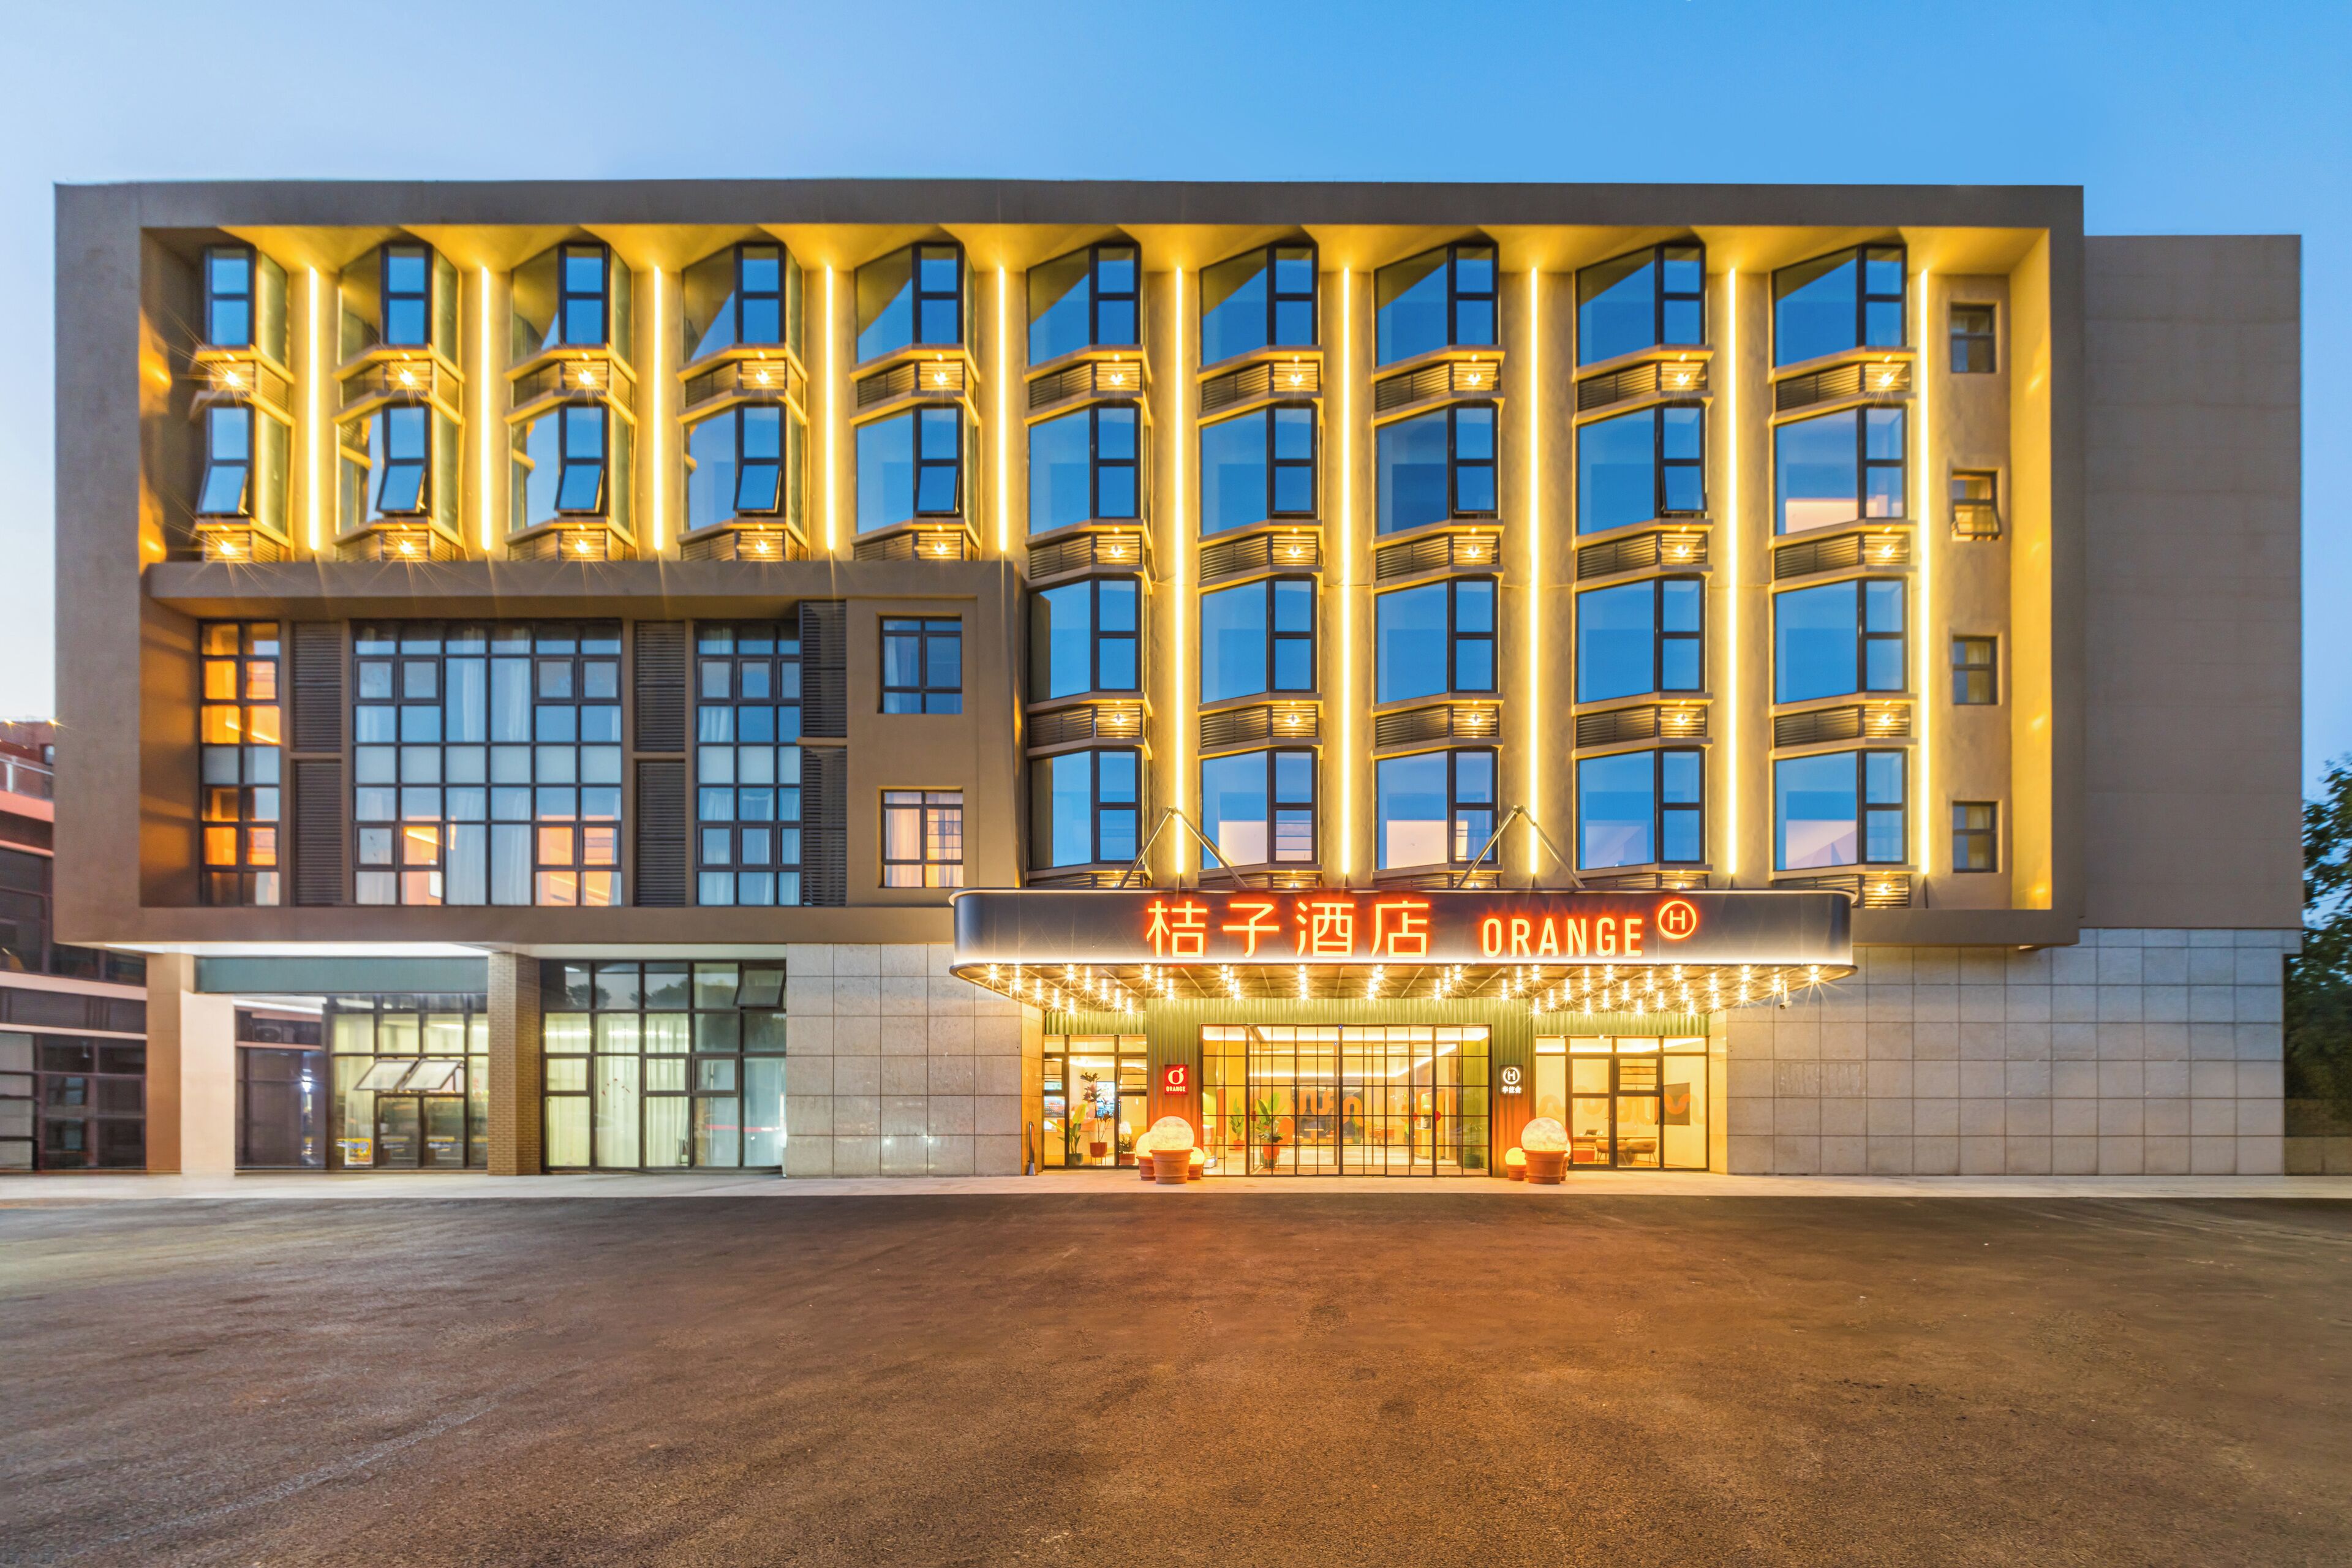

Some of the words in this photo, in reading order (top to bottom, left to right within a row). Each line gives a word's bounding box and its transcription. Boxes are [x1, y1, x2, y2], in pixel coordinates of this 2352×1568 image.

[1147, 900, 1429, 958] 桔子酒店
[1482, 918, 1643, 957] ORANGE
